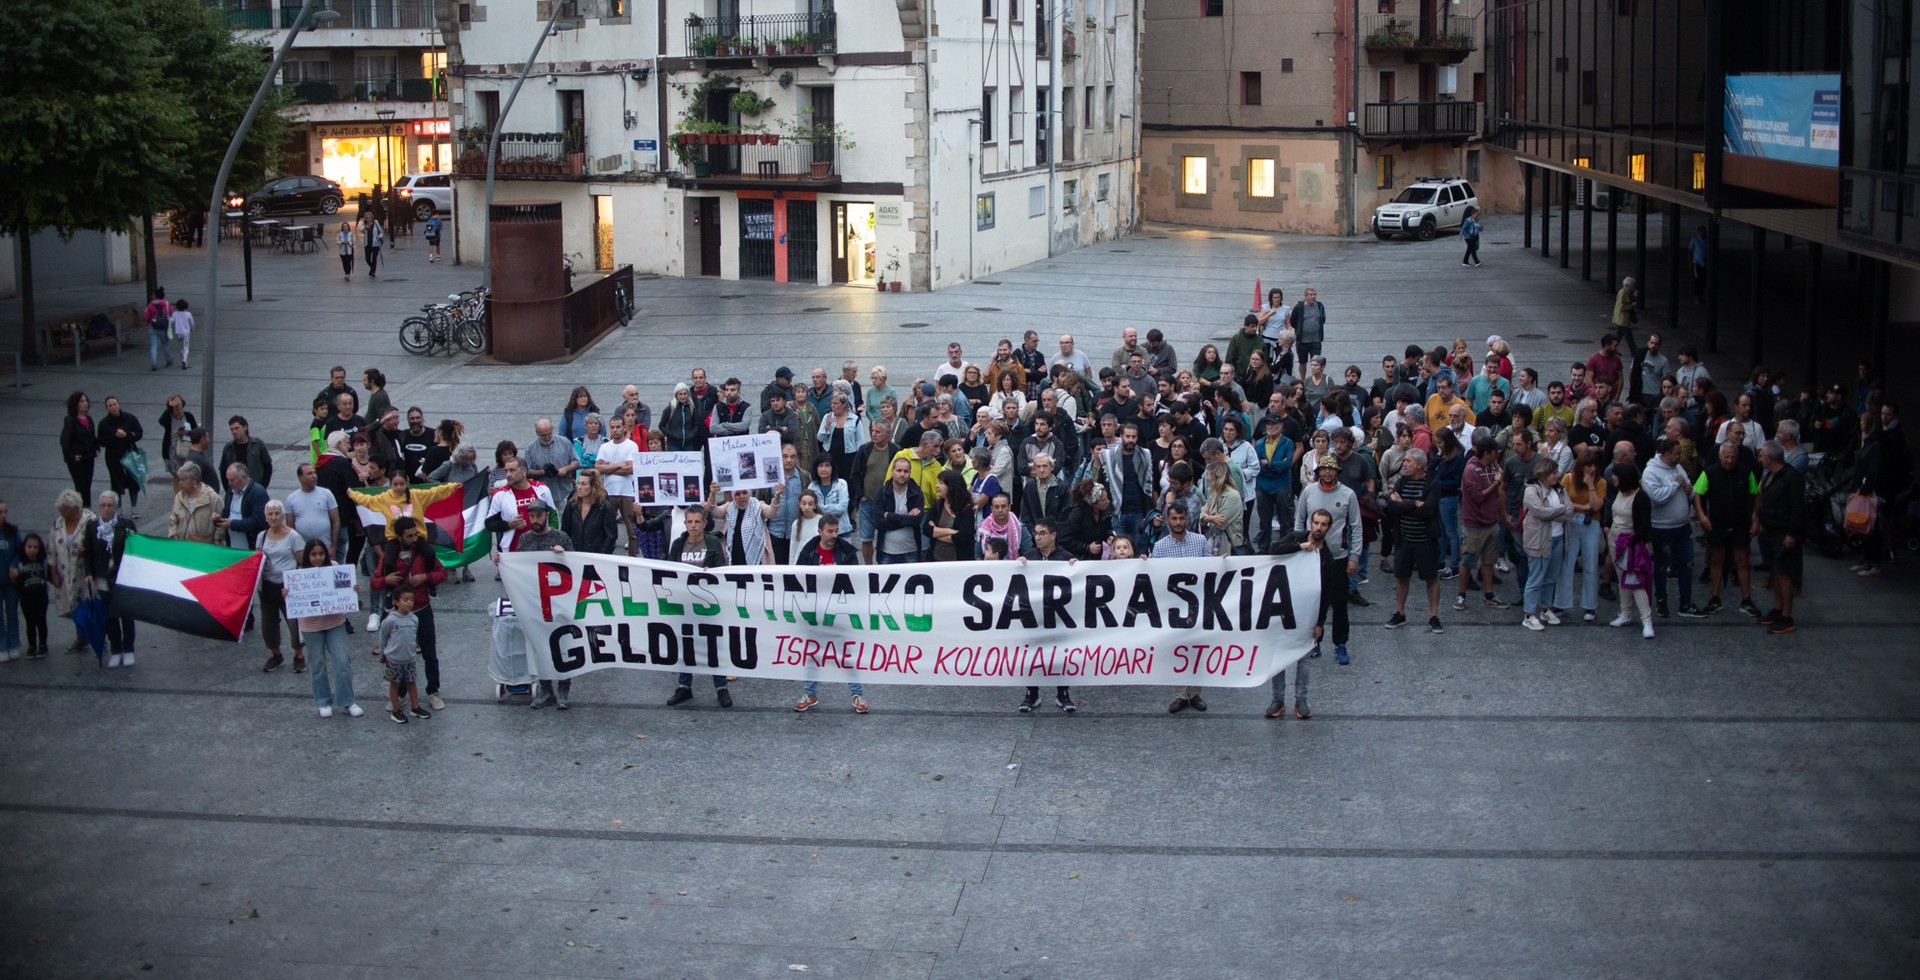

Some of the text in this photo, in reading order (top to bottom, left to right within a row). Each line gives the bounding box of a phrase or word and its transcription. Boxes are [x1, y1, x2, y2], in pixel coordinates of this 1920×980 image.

[330, 126, 389, 136] NATUR HOUS
[878, 206, 899, 214] ADATS
[286, 572, 322, 582] NO HACE
[288, 583, 310, 592] FALTA
[320, 604, 356, 614] HUMANO
[772, 635, 923, 675] ISRAELDAR
[1173, 644, 1259, 676] STOP!
